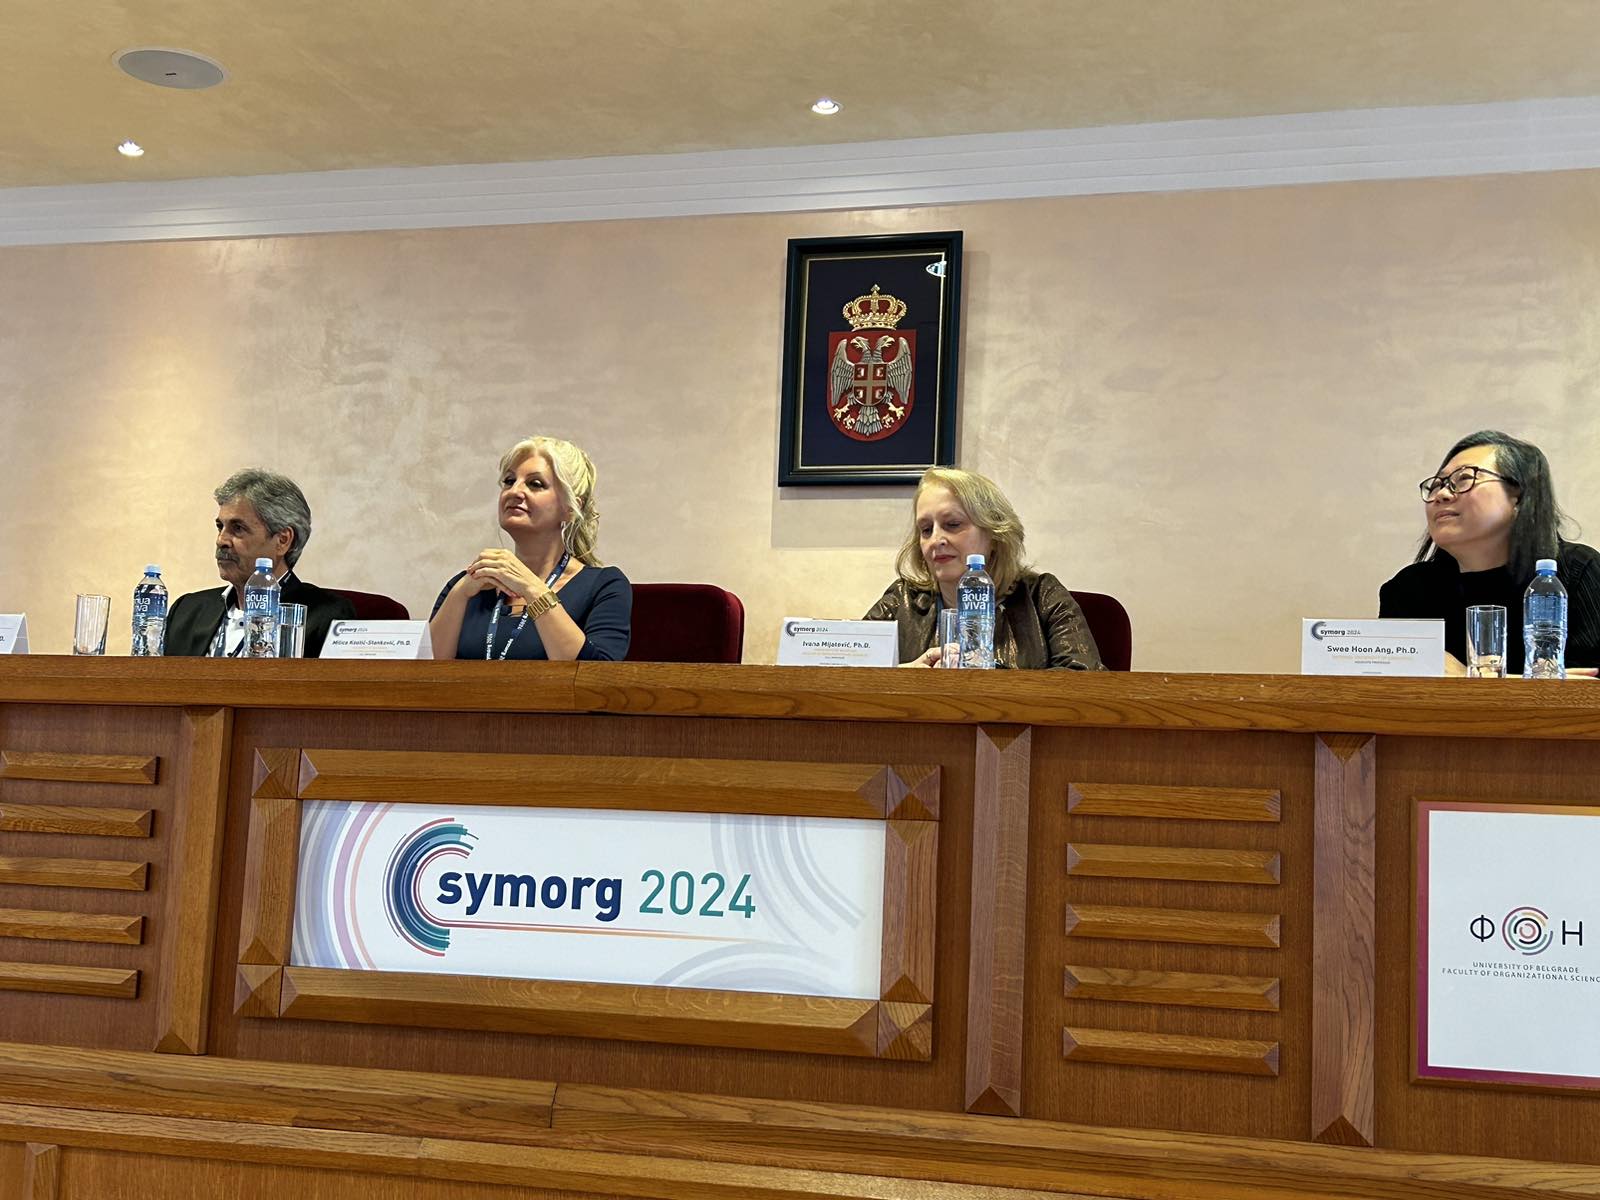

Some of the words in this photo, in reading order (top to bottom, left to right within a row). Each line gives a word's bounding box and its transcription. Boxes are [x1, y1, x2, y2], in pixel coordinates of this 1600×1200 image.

[246, 601, 266, 609] viva
[963, 601, 986, 610] viva
[853, 641, 871, 649] Ph.D.
[1327, 645, 1349, 653] Swee
[1351, 645, 1373, 653] Hoon
[1374, 646, 1394, 655] Ang,
[1396, 646, 1419, 654] Ph.D.
[436, 871, 623, 922] symorg
[639, 869, 756, 919] 2024
[1472, 961, 1520, 970] UNIVERSITY
[1536, 965, 1579, 974] BELGRADE
[1442, 967, 1478, 976] FACULTY
[1480, 969, 1491, 977] OF
[1493, 971, 1568, 981] ORGANIZATIONAL
